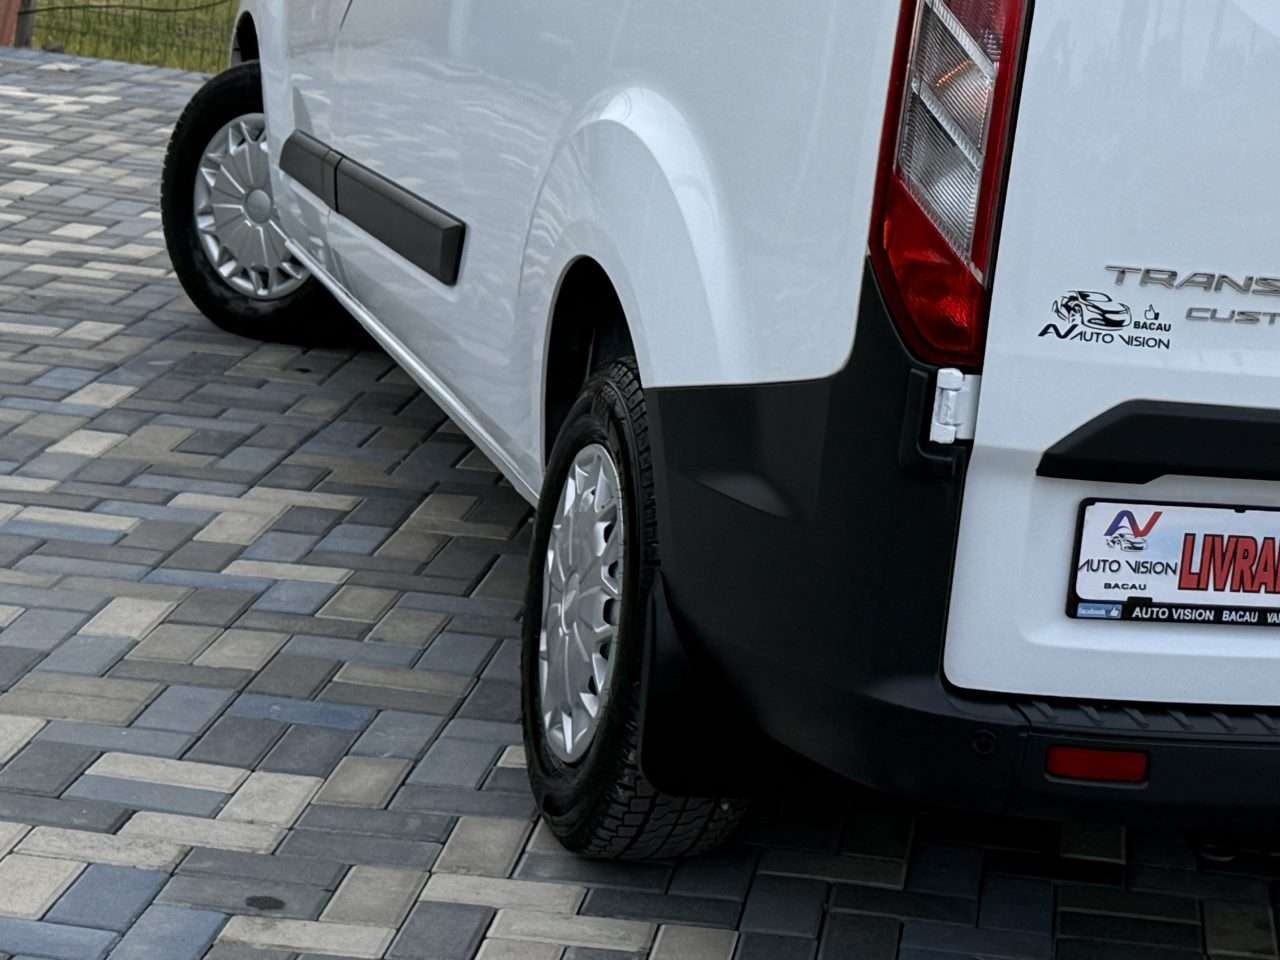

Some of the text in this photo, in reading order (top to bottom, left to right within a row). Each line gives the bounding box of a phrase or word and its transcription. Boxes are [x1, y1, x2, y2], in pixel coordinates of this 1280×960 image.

[1133, 321, 1171, 332] BACAU
[1070, 331, 1170, 349] AUTO VISION
[1078, 559, 1178, 575] AUTO VISION
[1104, 582, 1147, 591] BACAU
[1132, 607, 1169, 619] AUTO
[1172, 608, 1215, 621] VISION
[1222, 610, 1259, 623] BACAU
